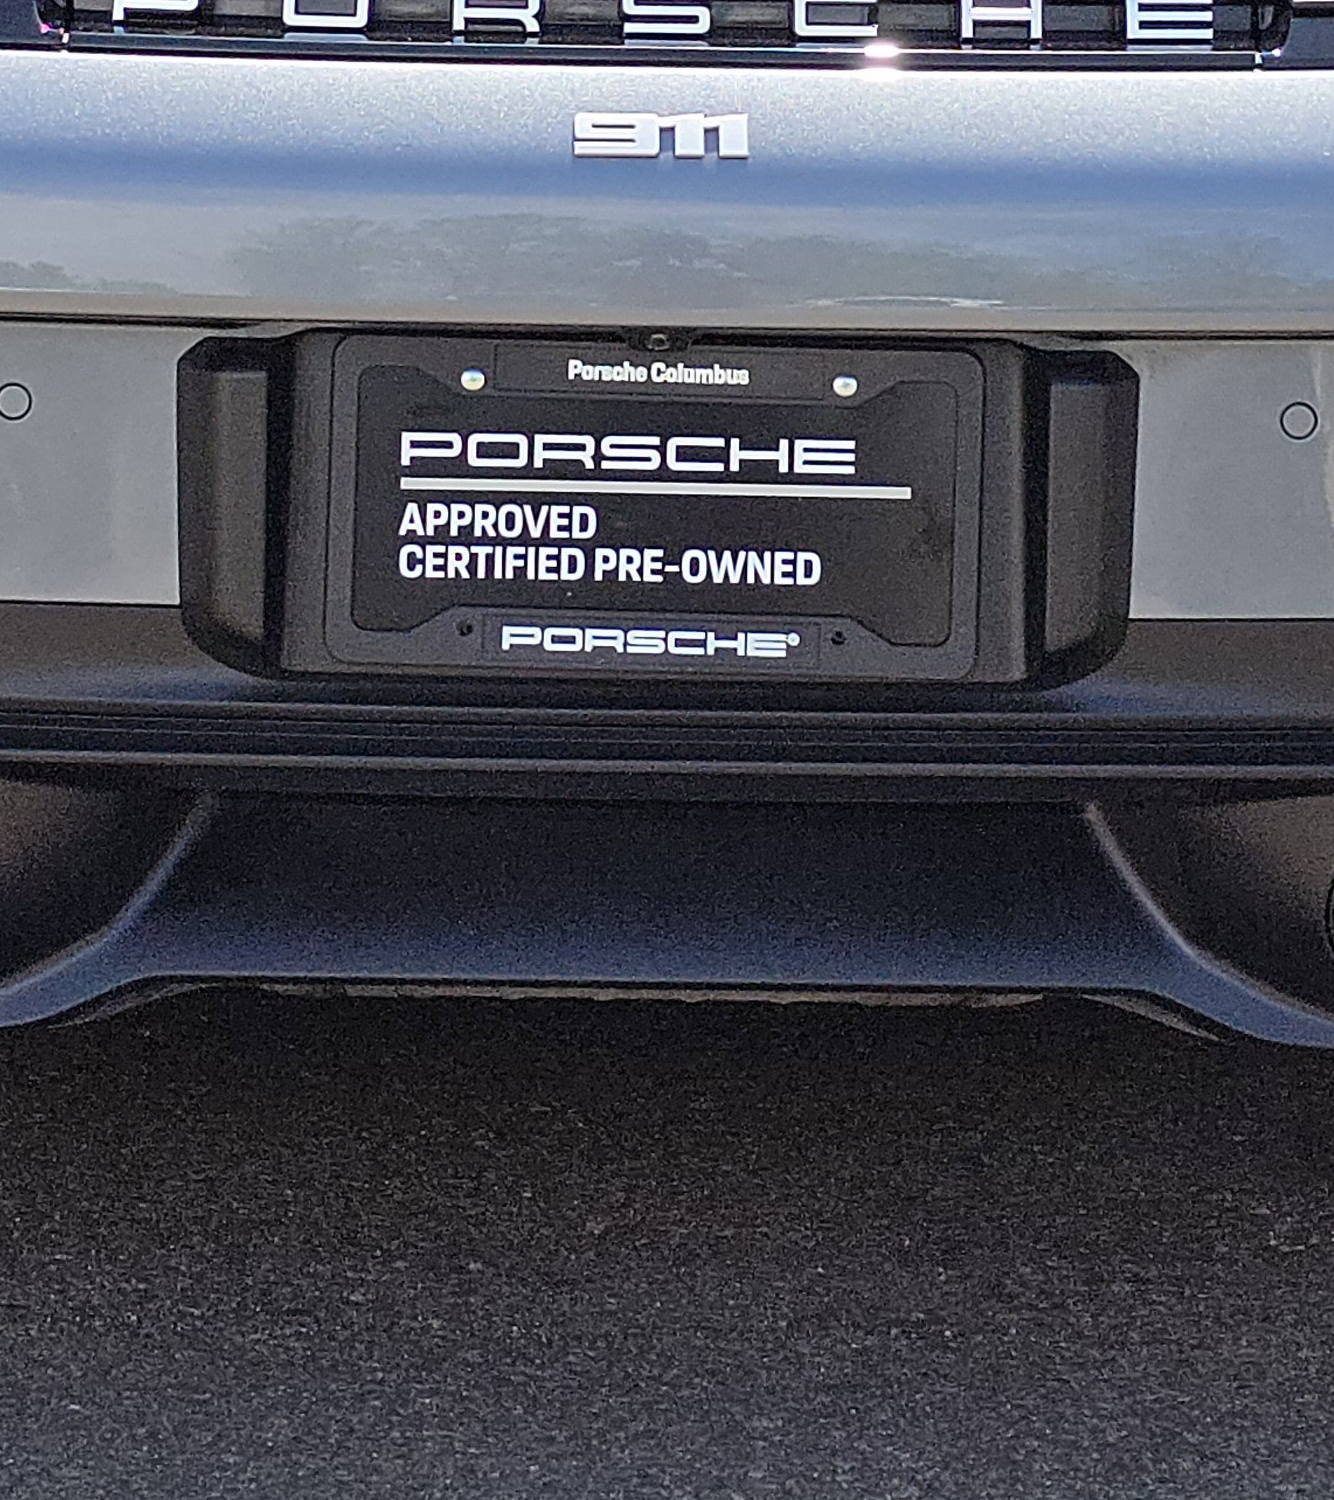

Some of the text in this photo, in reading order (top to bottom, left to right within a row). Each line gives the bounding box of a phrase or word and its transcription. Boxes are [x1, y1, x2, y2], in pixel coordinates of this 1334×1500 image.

[573, 111, 750, 159] 911
[568, 359, 750, 385] Porsche Columbus
[400, 432, 856, 474] PORSCHE
[399, 503, 597, 539] APPROVED
[399, 544, 821, 585] CERTIFIED PRE-OWNED
